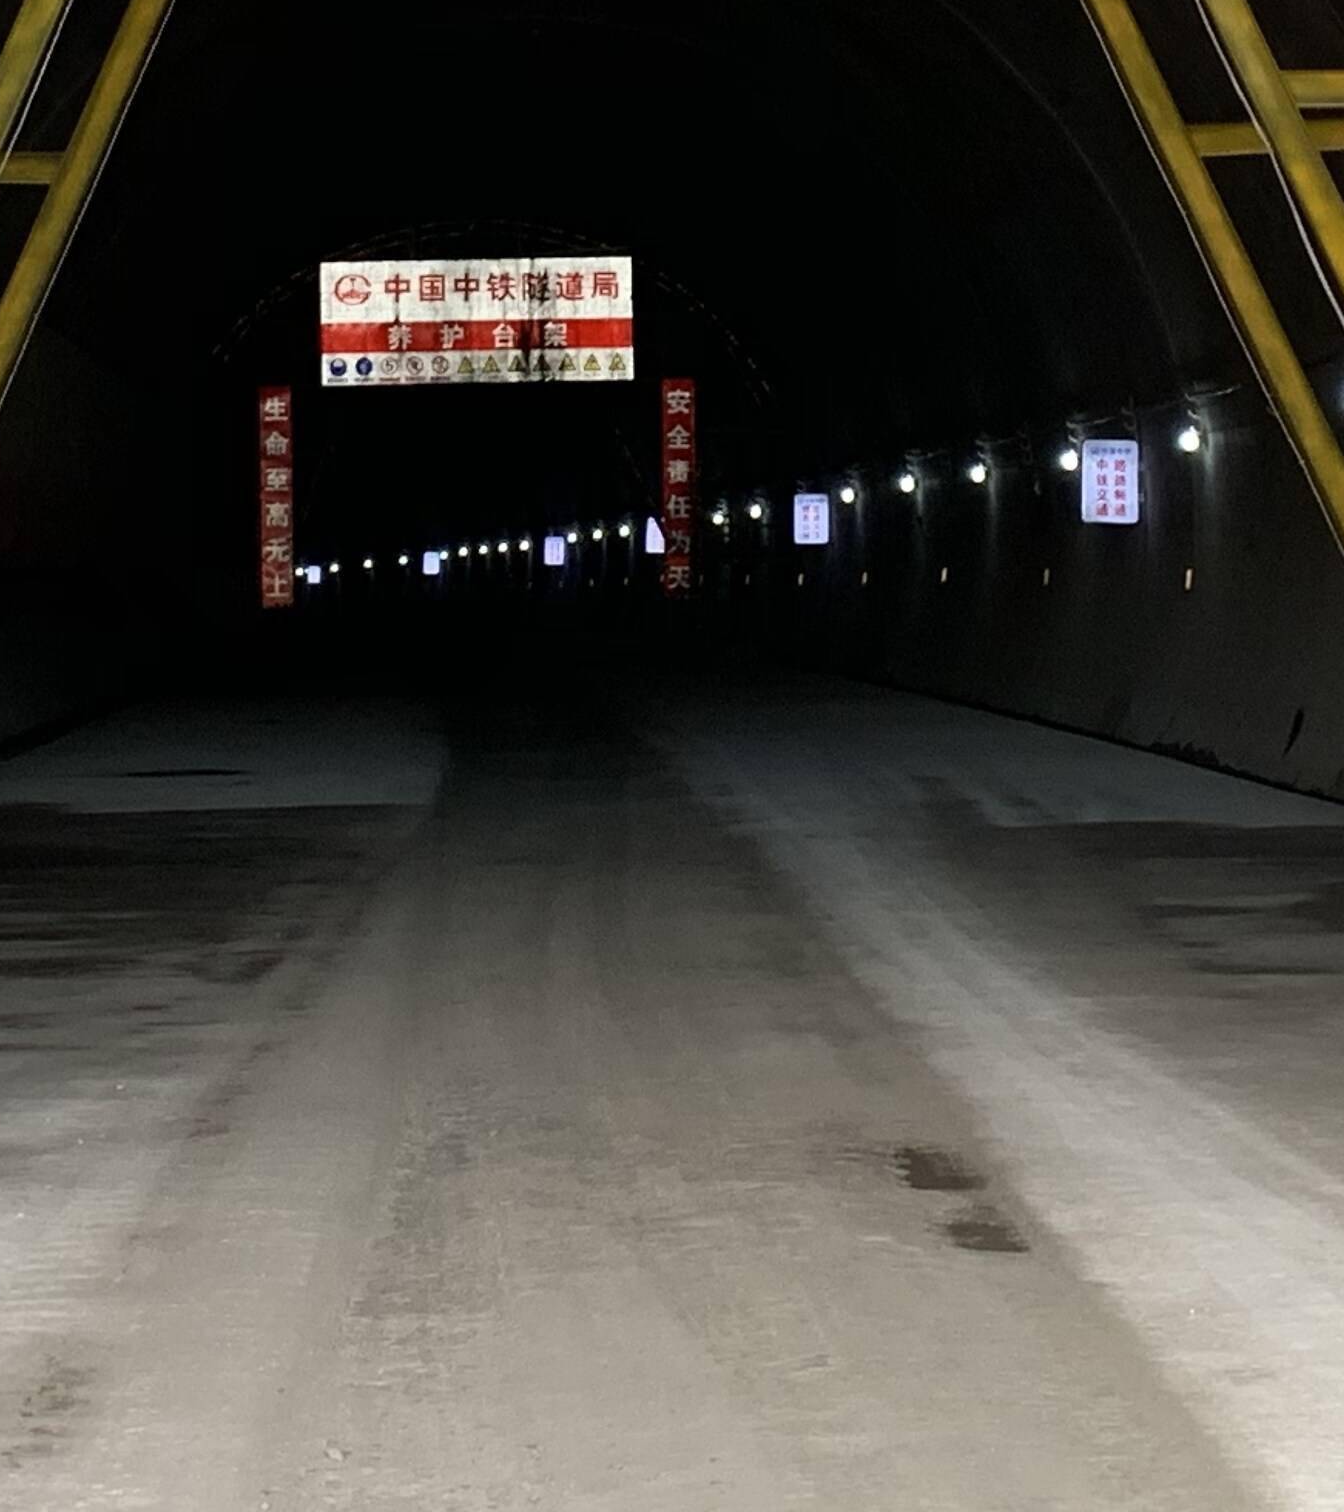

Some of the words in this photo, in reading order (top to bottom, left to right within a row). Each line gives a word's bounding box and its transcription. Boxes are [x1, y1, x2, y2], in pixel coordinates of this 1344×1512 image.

[384, 271, 619, 303] 中国中铁隧道局
[388, 322, 568, 350] 养护台架
[666, 389, 692, 590] 安全责任为天
